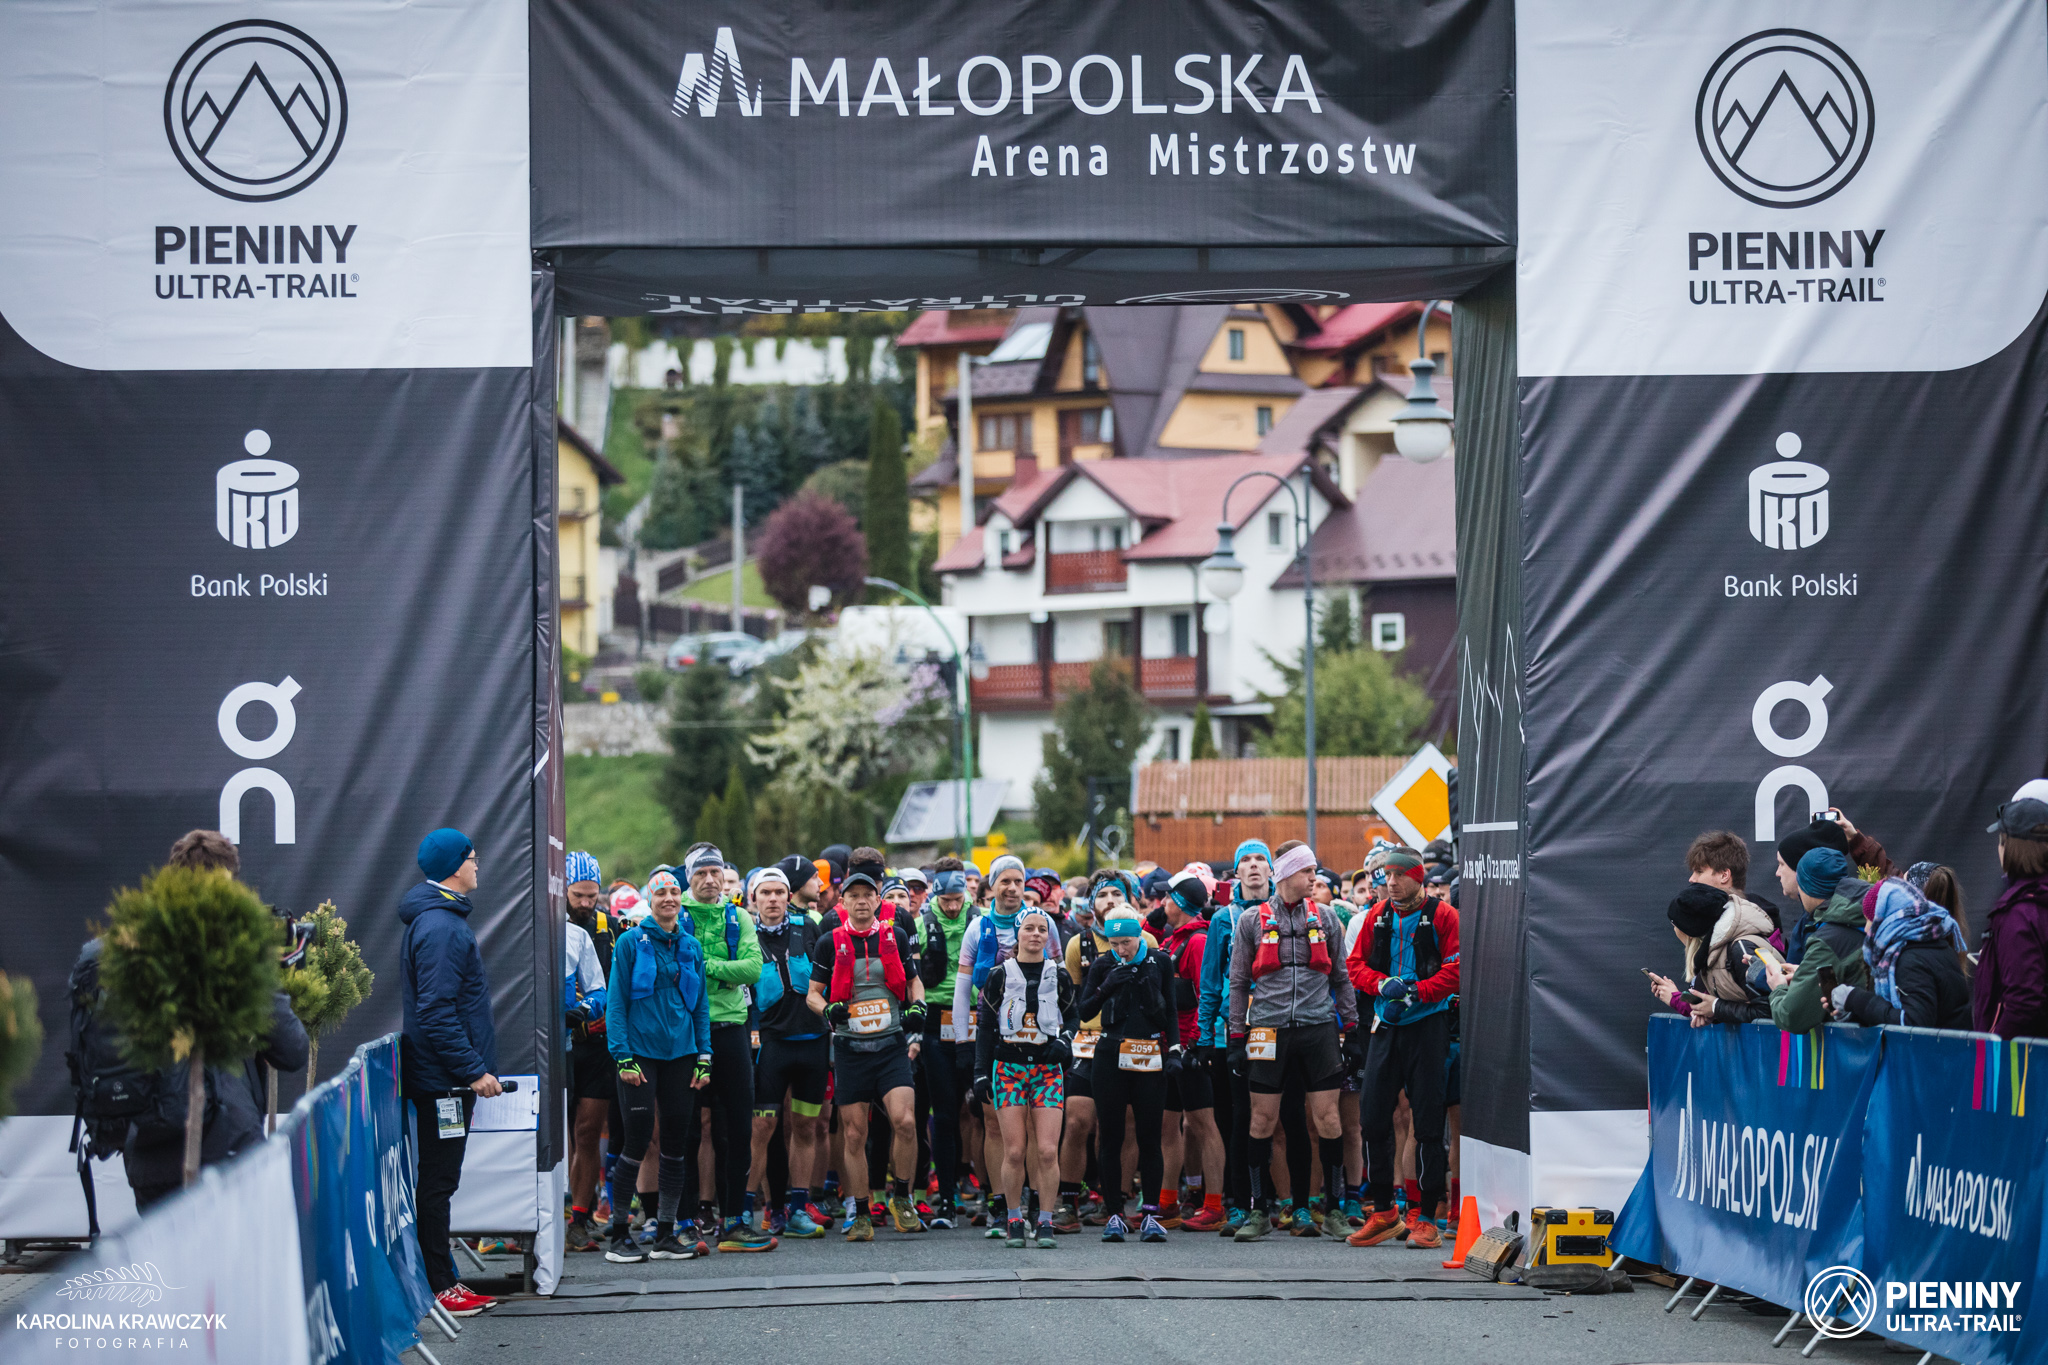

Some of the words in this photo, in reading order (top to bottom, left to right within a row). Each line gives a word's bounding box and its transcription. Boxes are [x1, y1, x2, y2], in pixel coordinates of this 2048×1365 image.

[790, 54, 1322, 117] MAŁOPOLSKA
[972, 135, 1108, 177] Arena
[1150, 133, 1416, 176] Mistrzostw
[156, 225, 357, 264] PIENINY
[1689, 230, 1886, 271] PIENINY
[191, 574, 251, 597] Bank
[260, 573, 328, 597] Polski
[1724, 574, 1783, 598] Bank
[1792, 573, 1858, 597] Polski
[857, 1004, 881, 1016] 3038
[1130, 1043, 1153, 1054] 3059
[1249, 1032, 1266, 1042] 3248
[1700, 1119, 1839, 1231] MAŁOPOLSK
